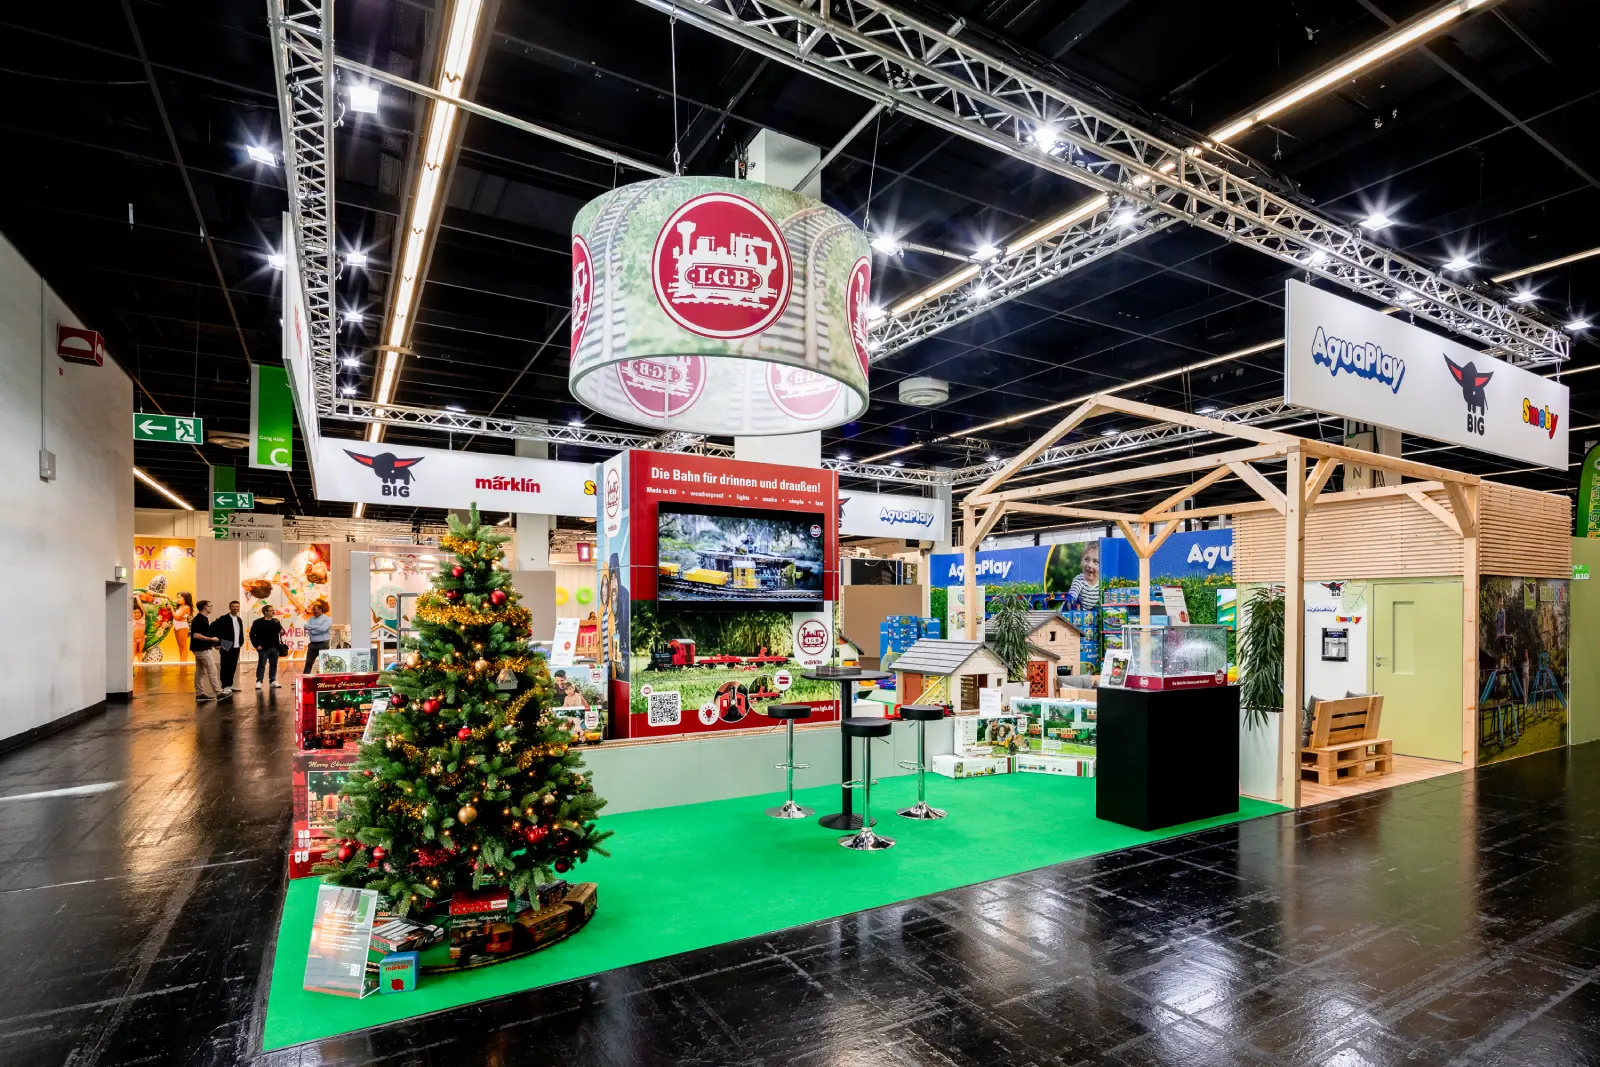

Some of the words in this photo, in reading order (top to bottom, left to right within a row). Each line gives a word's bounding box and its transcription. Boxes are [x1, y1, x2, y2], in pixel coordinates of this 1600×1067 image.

[1311, 326, 1405, 394] AquaPlay
[1466, 413, 1485, 436] BIG
[1522, 397, 1558, 439] Smoby
[270, 448, 288, 467] C
[475, 476, 541, 494] märklin
[651, 466, 670, 480] Die
[672, 468, 701, 483] Bahn
[702, 472, 718, 485] für
[719, 473, 757, 487] drinnen
[759, 478, 778, 490] und
[779, 479, 821, 494] draußen!
[381, 484, 410, 498] BIG
[646, 486, 662, 494] Made
[662, 487, 669, 495] in
[690, 490, 724, 499] weatherproof
[735, 493, 750, 501] lights
[788, 498, 804, 506] simple
[230, 515, 237, 523] 2
[247, 516, 255, 524] 4
[880, 507, 935, 527] AquaPlay
[134, 546, 156, 557] DY
[163, 547, 196, 558] FOR
[134, 560, 173, 570] MER
[948, 559, 1012, 582] AqaPlay
[1335, 615, 1362, 624] Smoby
[307, 761, 329, 769] Merry
